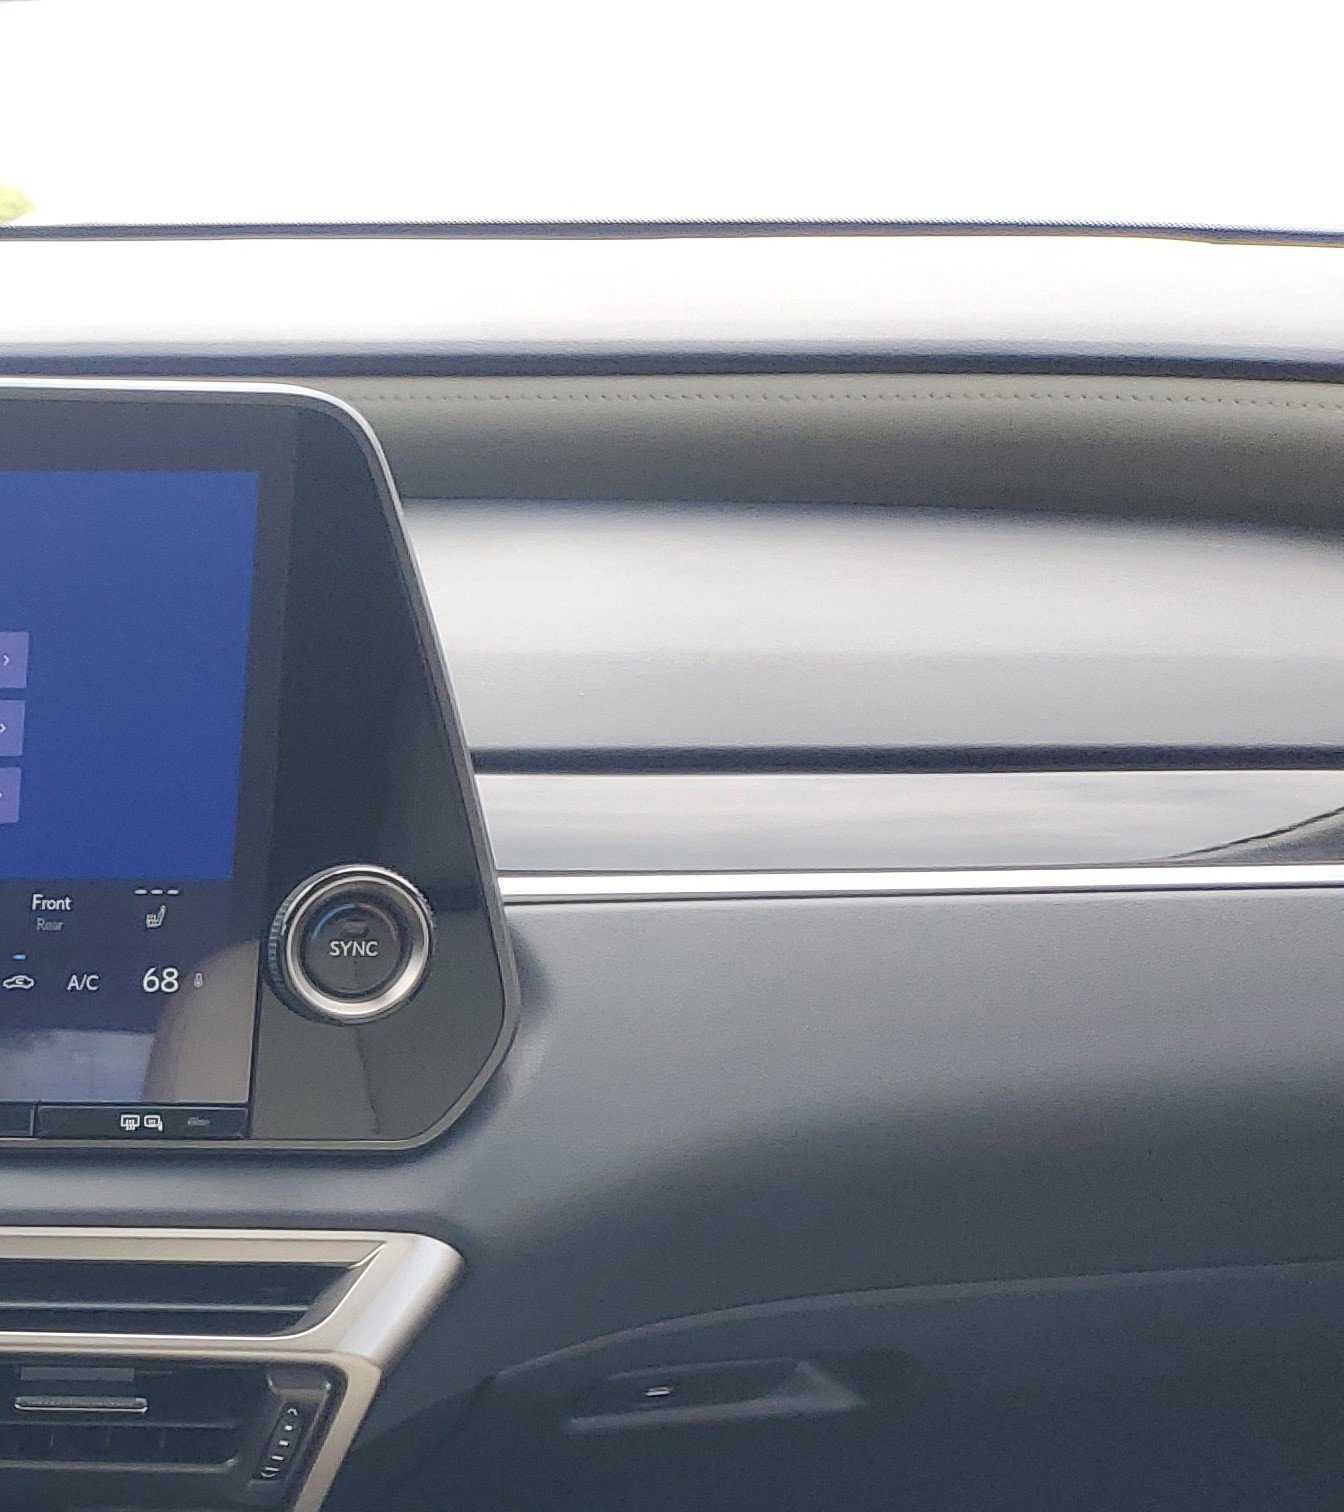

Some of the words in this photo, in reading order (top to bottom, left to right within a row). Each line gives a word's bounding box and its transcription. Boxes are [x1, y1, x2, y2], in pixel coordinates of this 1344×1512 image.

[31, 894, 72, 911] Front
[36, 917, 64, 931] Rear
[329, 940, 379, 957] SYNC
[67, 974, 100, 991] A/C
[142, 967, 179, 993] 68
